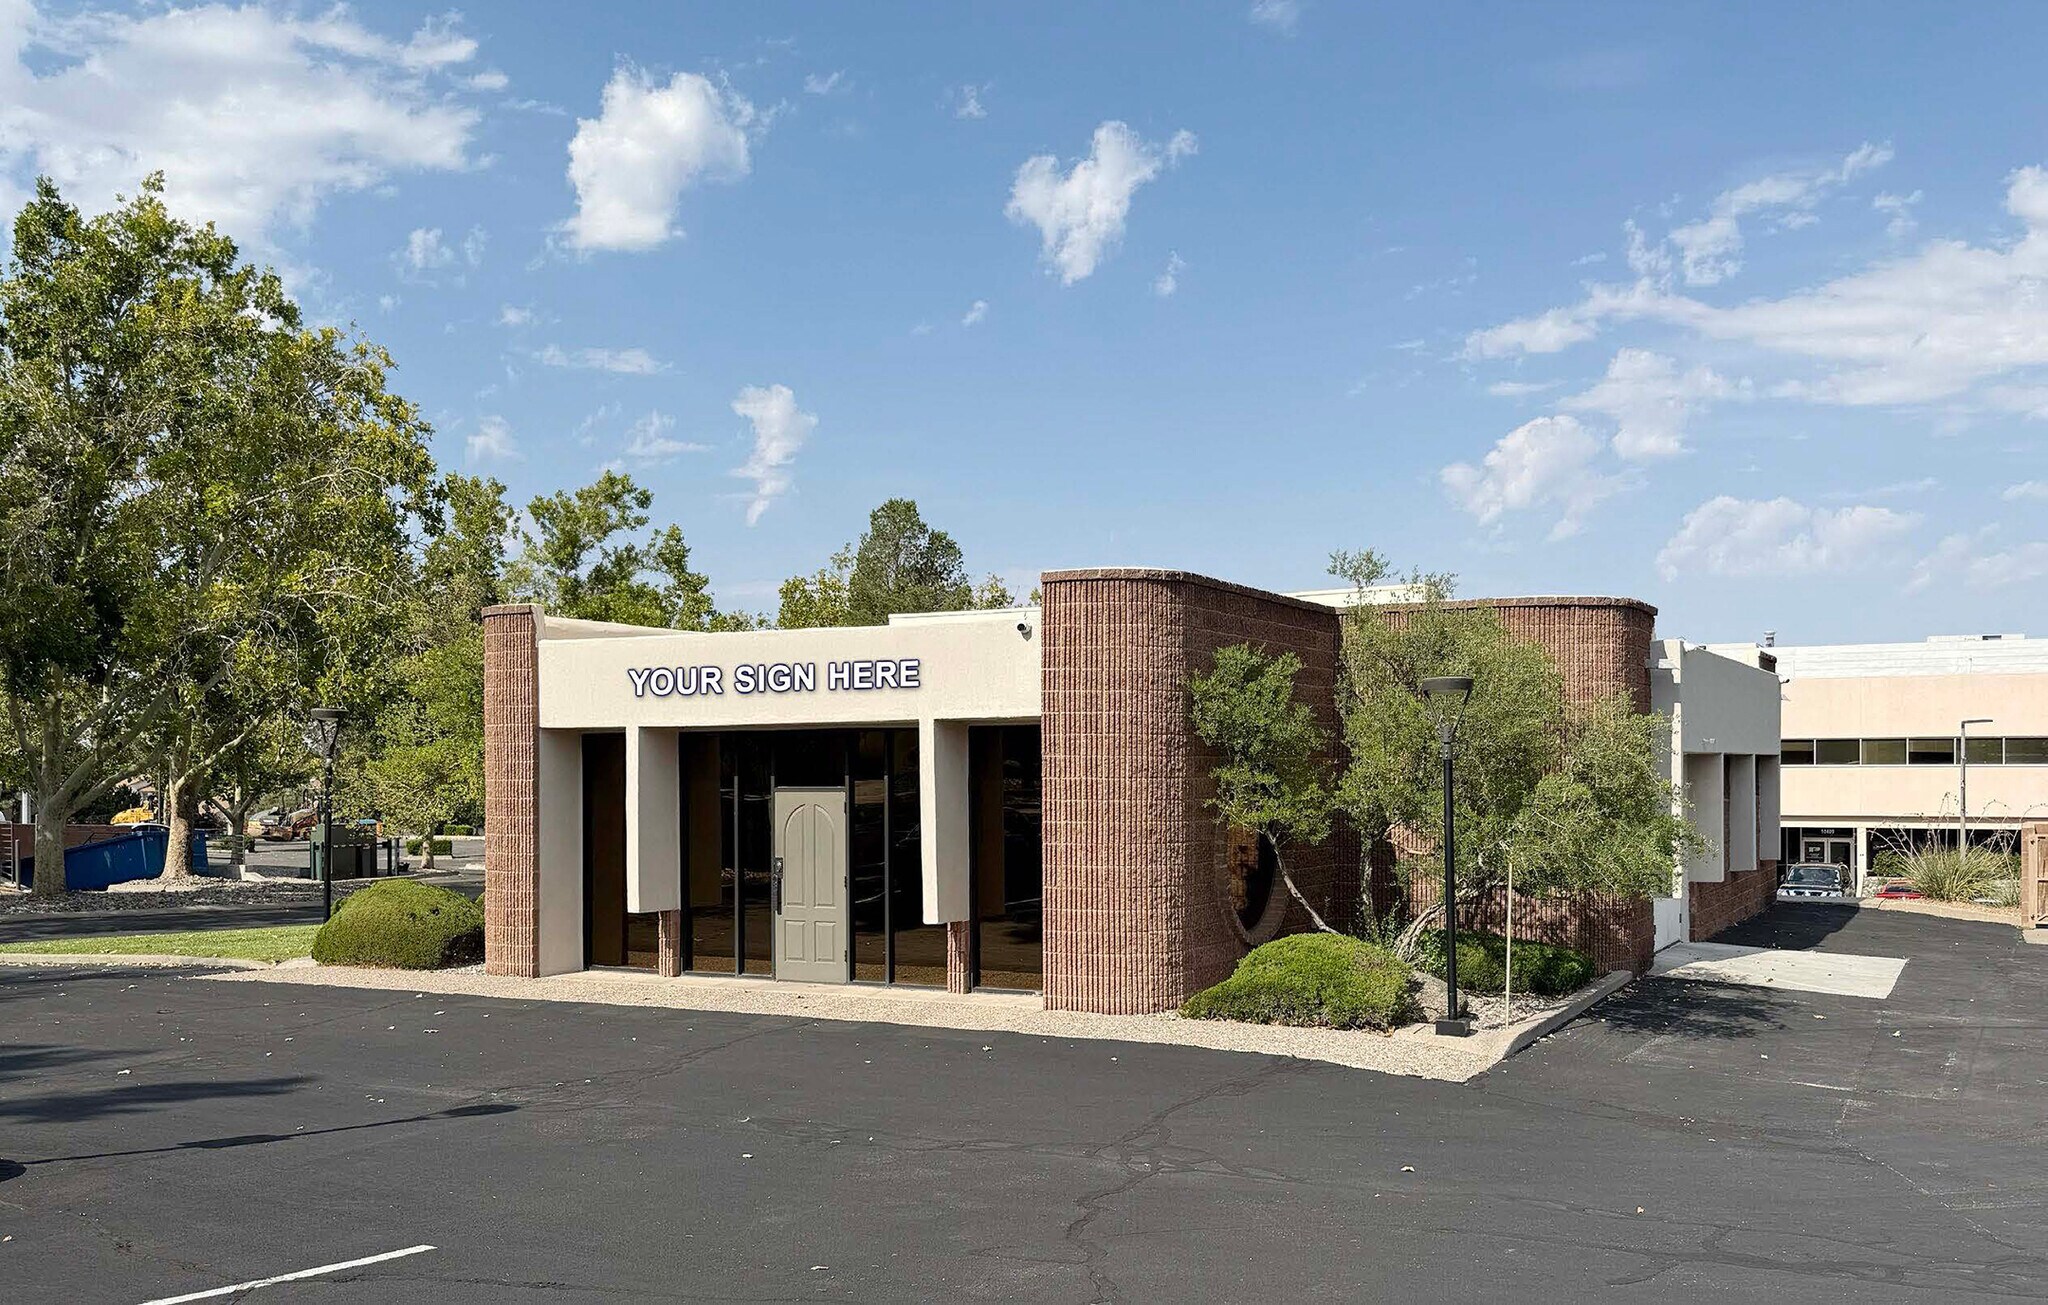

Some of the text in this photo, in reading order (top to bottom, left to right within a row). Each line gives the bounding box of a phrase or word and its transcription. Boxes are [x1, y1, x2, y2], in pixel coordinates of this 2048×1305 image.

[627, 658, 921, 697] YOUR SIGN HERE
